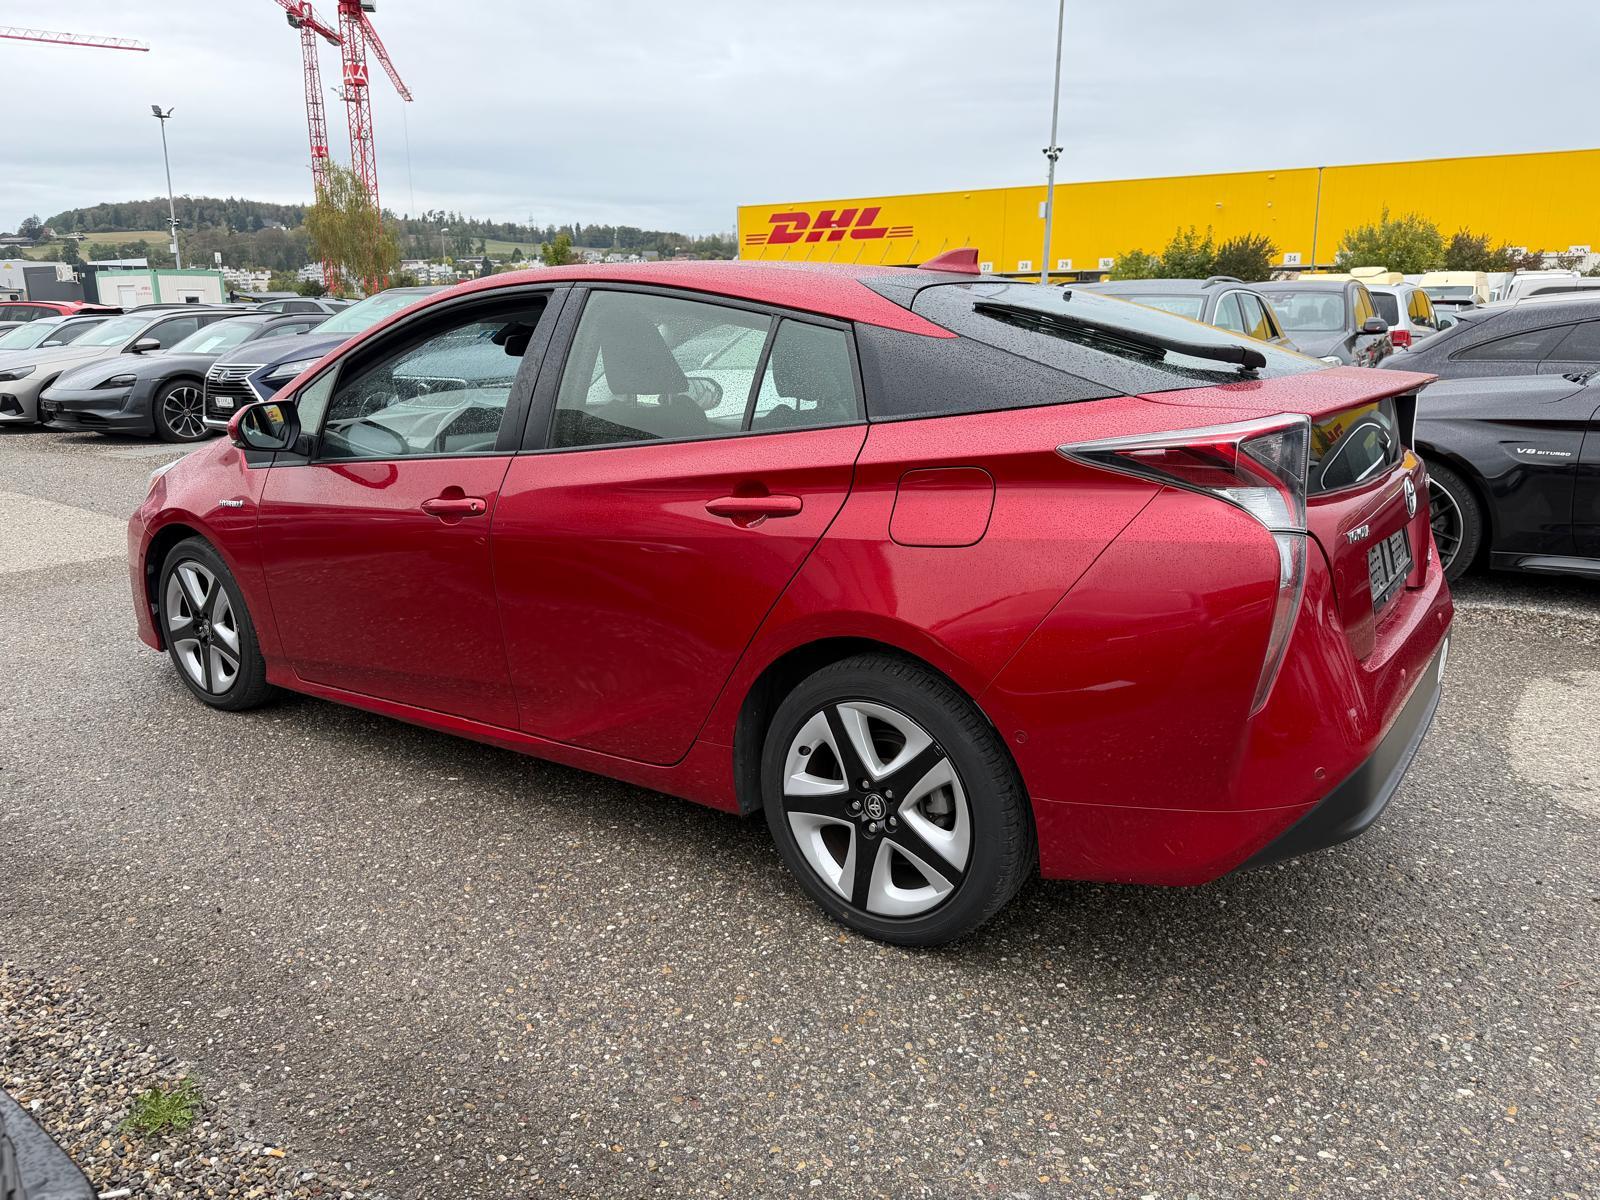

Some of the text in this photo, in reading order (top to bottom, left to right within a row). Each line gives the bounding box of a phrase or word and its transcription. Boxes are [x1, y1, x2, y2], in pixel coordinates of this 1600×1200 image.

[766, 206, 883, 244] DHL
[982, 263, 991, 272] 27
[1020, 262, 1029, 270] 28
[1060, 260, 1069, 269] 29
[1516, 447, 1537, 455] V8
